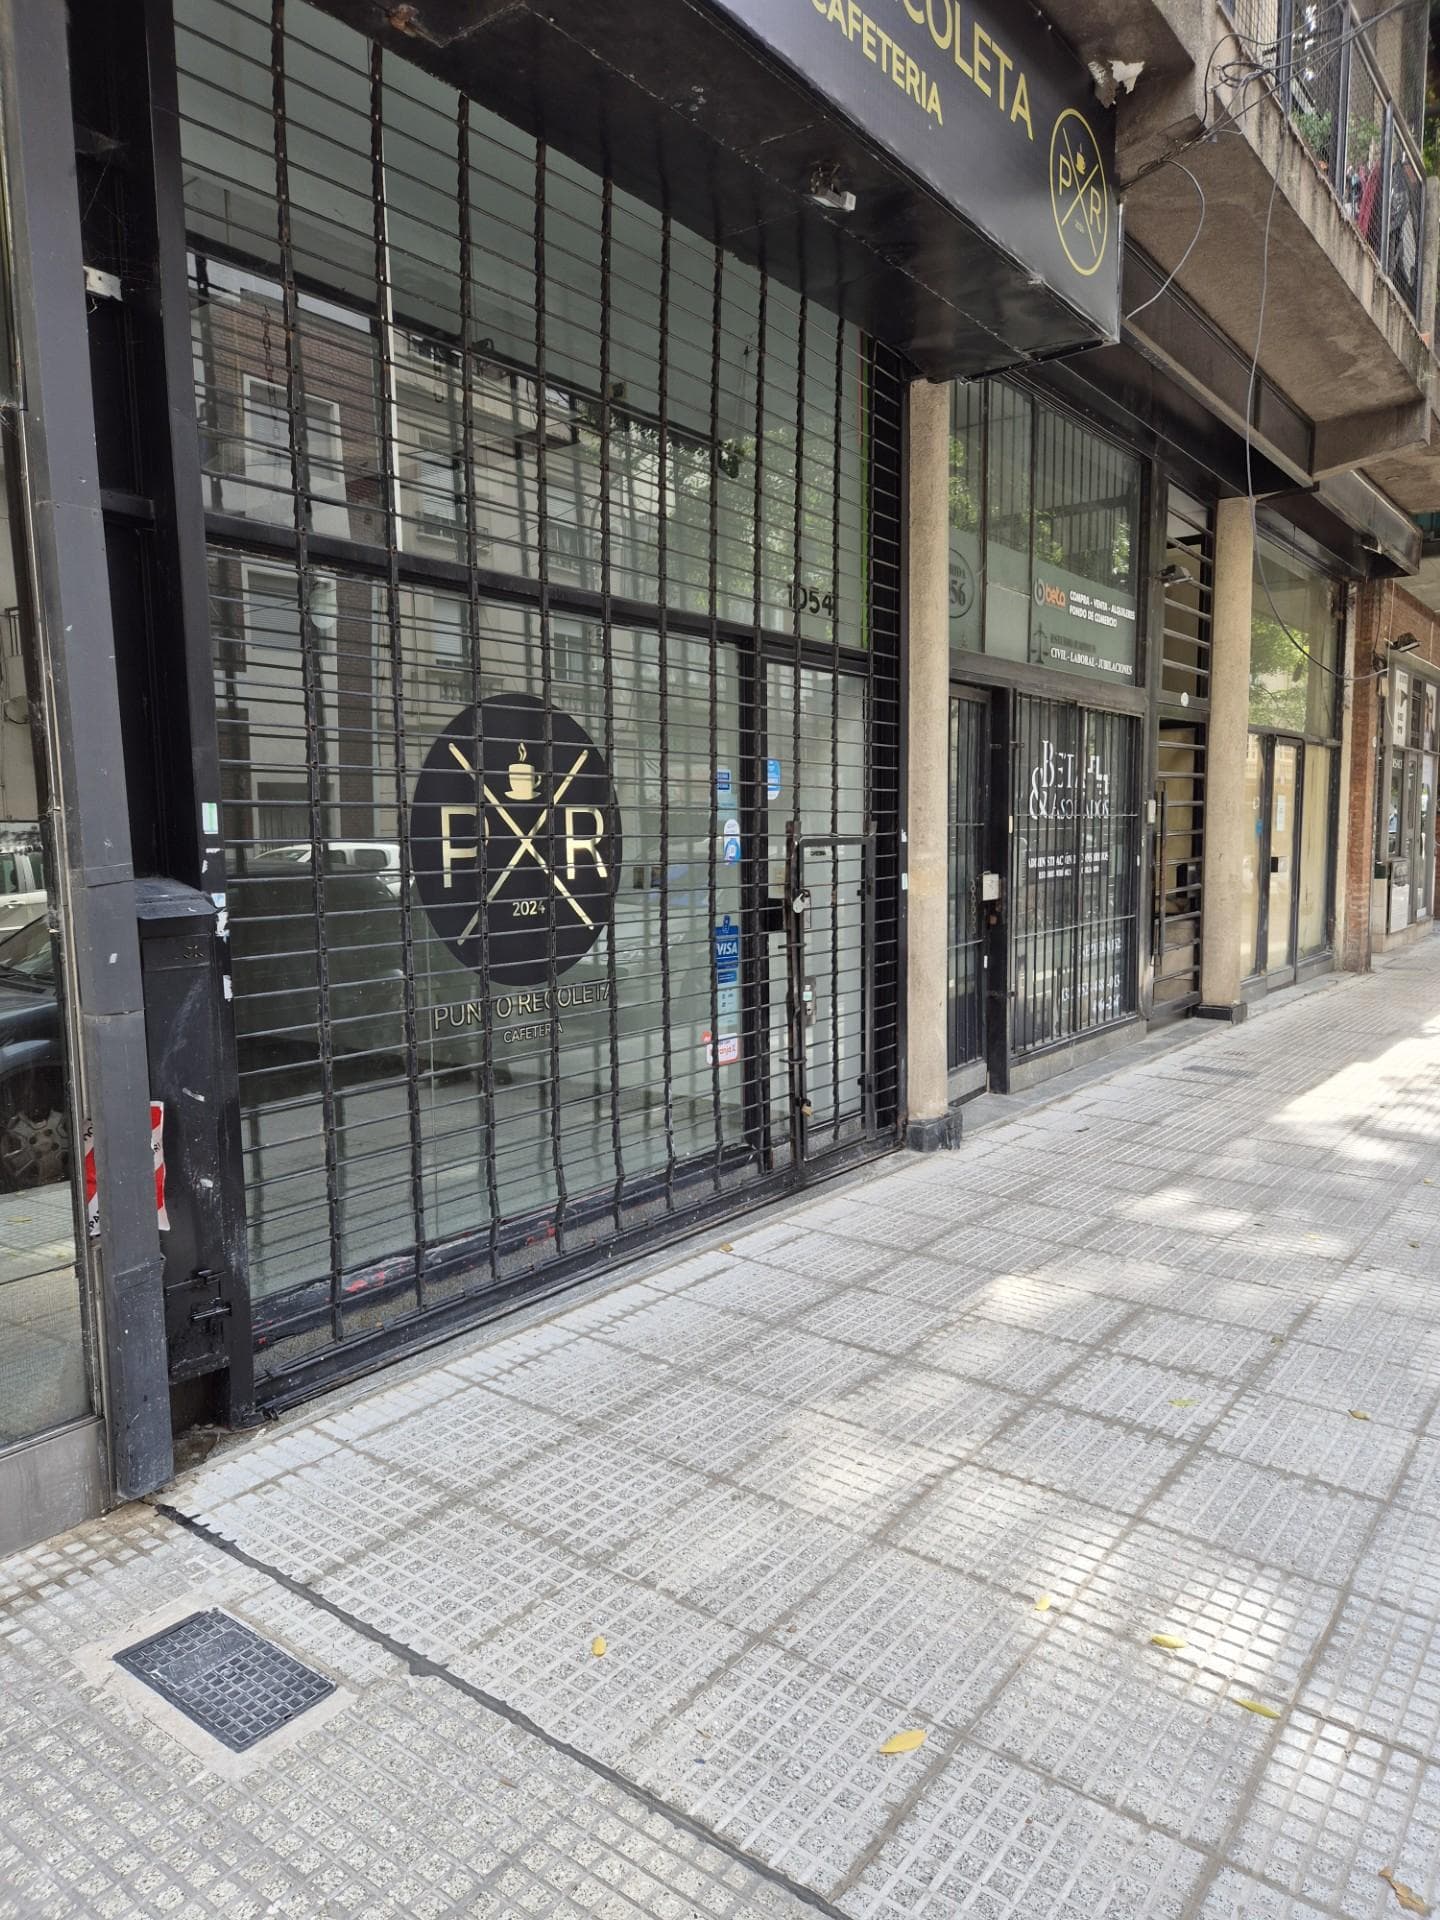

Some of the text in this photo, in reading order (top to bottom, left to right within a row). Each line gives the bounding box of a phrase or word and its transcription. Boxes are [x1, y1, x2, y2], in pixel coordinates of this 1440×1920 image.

[1069, 590, 1090, 606] COMPRA
[1093, 598, 1108, 612] VENTA
[1069, 604, 1088, 619] FONDO
[1087, 610, 1094, 621] DE
[1050, 647, 1067, 661] CIVIL
[1070, 651, 1096, 667] LABORAL
[512, 901, 546, 917] 2024
[716, 942, 738, 956] VISA
[434, 996, 513, 1031] PUNO
[503, 1021, 564, 1043] CAFETERA
